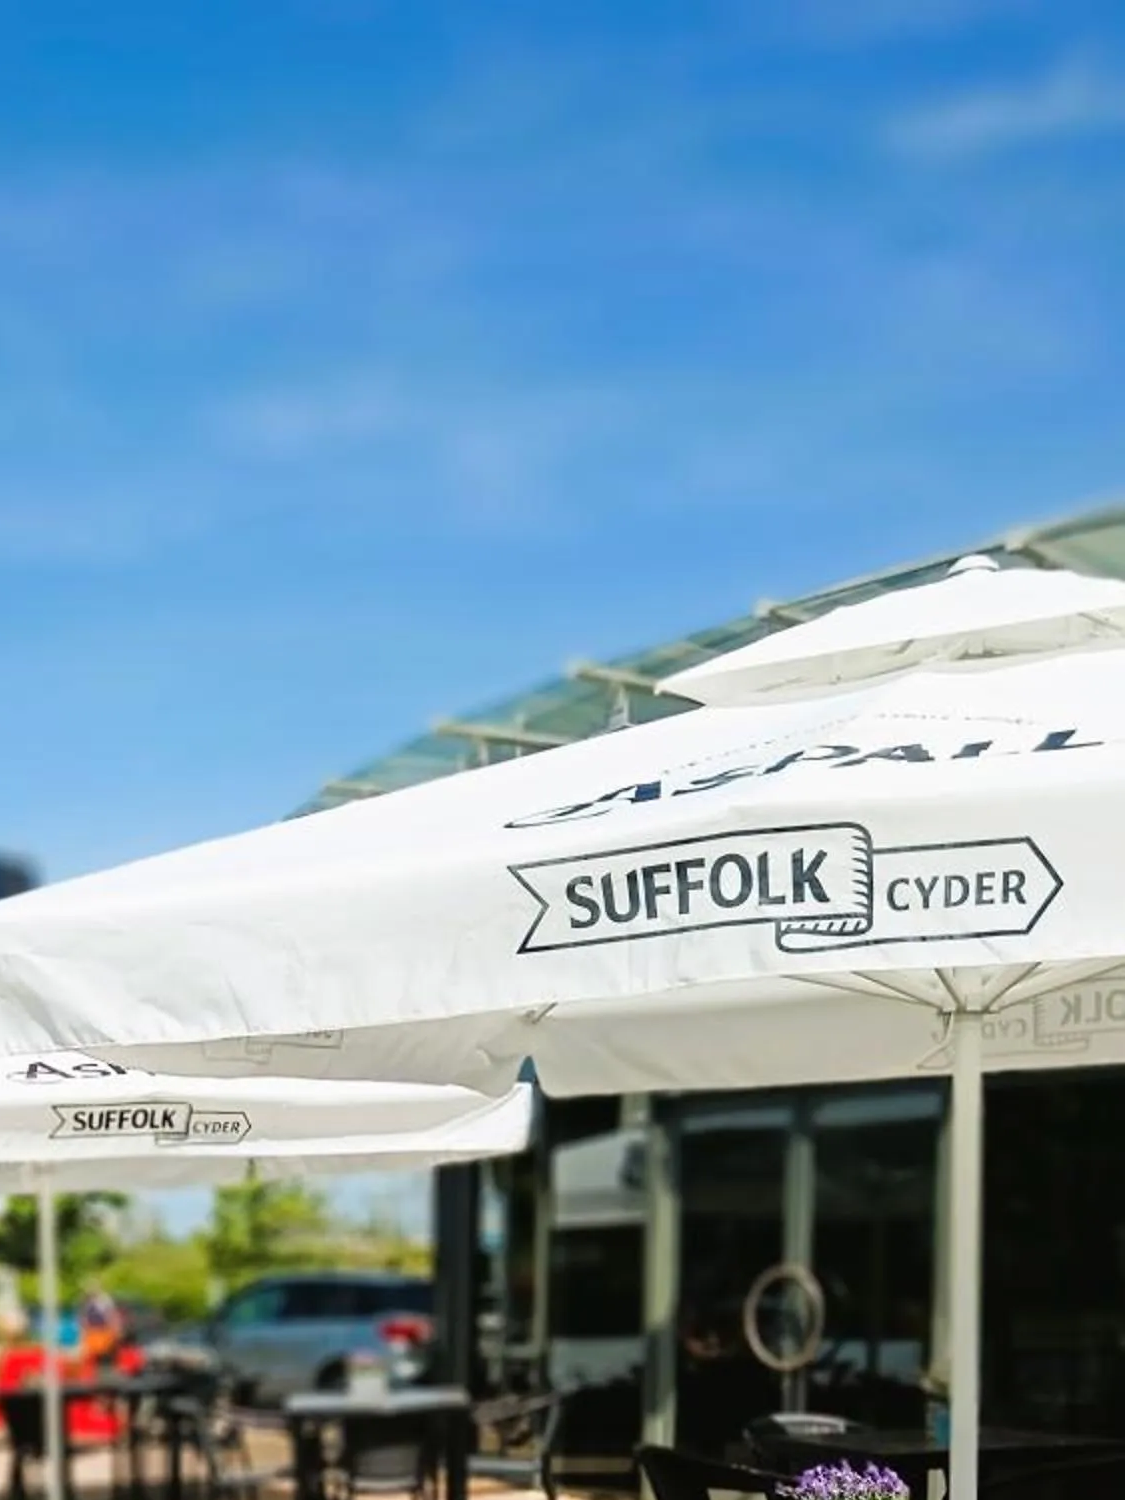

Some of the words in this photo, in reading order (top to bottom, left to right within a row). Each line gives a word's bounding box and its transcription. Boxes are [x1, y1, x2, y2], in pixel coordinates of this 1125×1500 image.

[564, 847, 831, 930] SUFFOLK
[885, 868, 1028, 913] CYDER
[72, 1108, 177, 1132] SUFFOLK
[192, 1120, 242, 1135] CYDER
